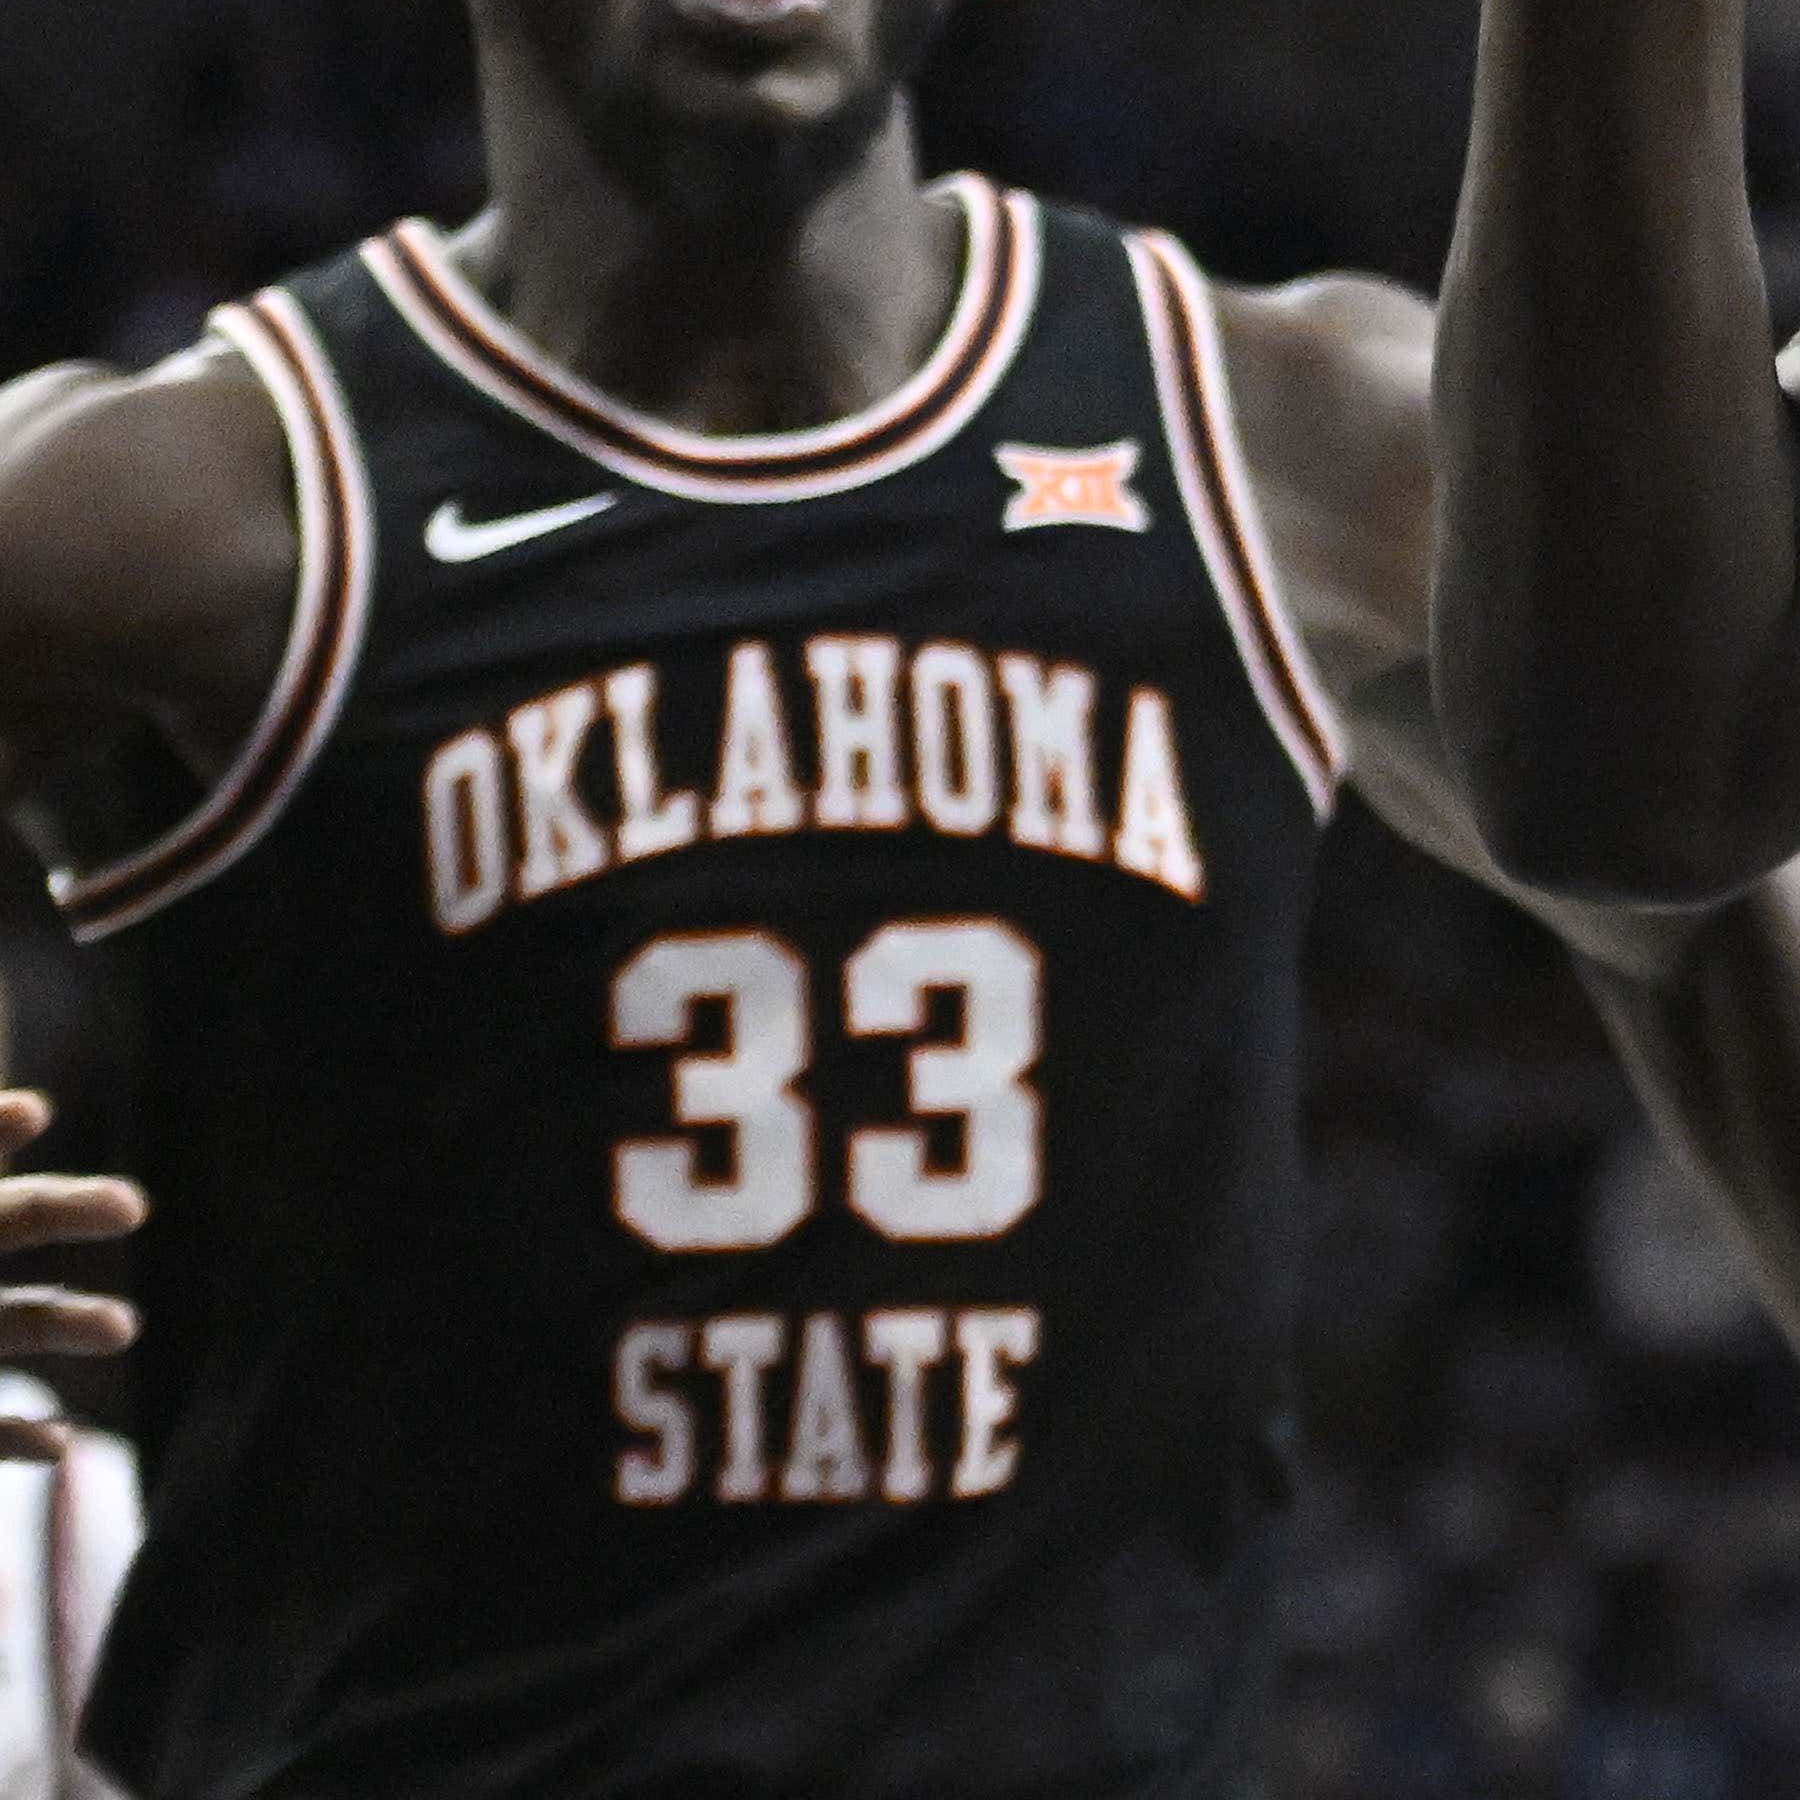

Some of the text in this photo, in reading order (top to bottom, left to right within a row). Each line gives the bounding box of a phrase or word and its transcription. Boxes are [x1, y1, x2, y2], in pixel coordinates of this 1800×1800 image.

[424, 634, 1203, 935] OKLAHOMA
[609, 917, 1045, 1254] 33
[611, 1304, 1041, 1506] STATE
